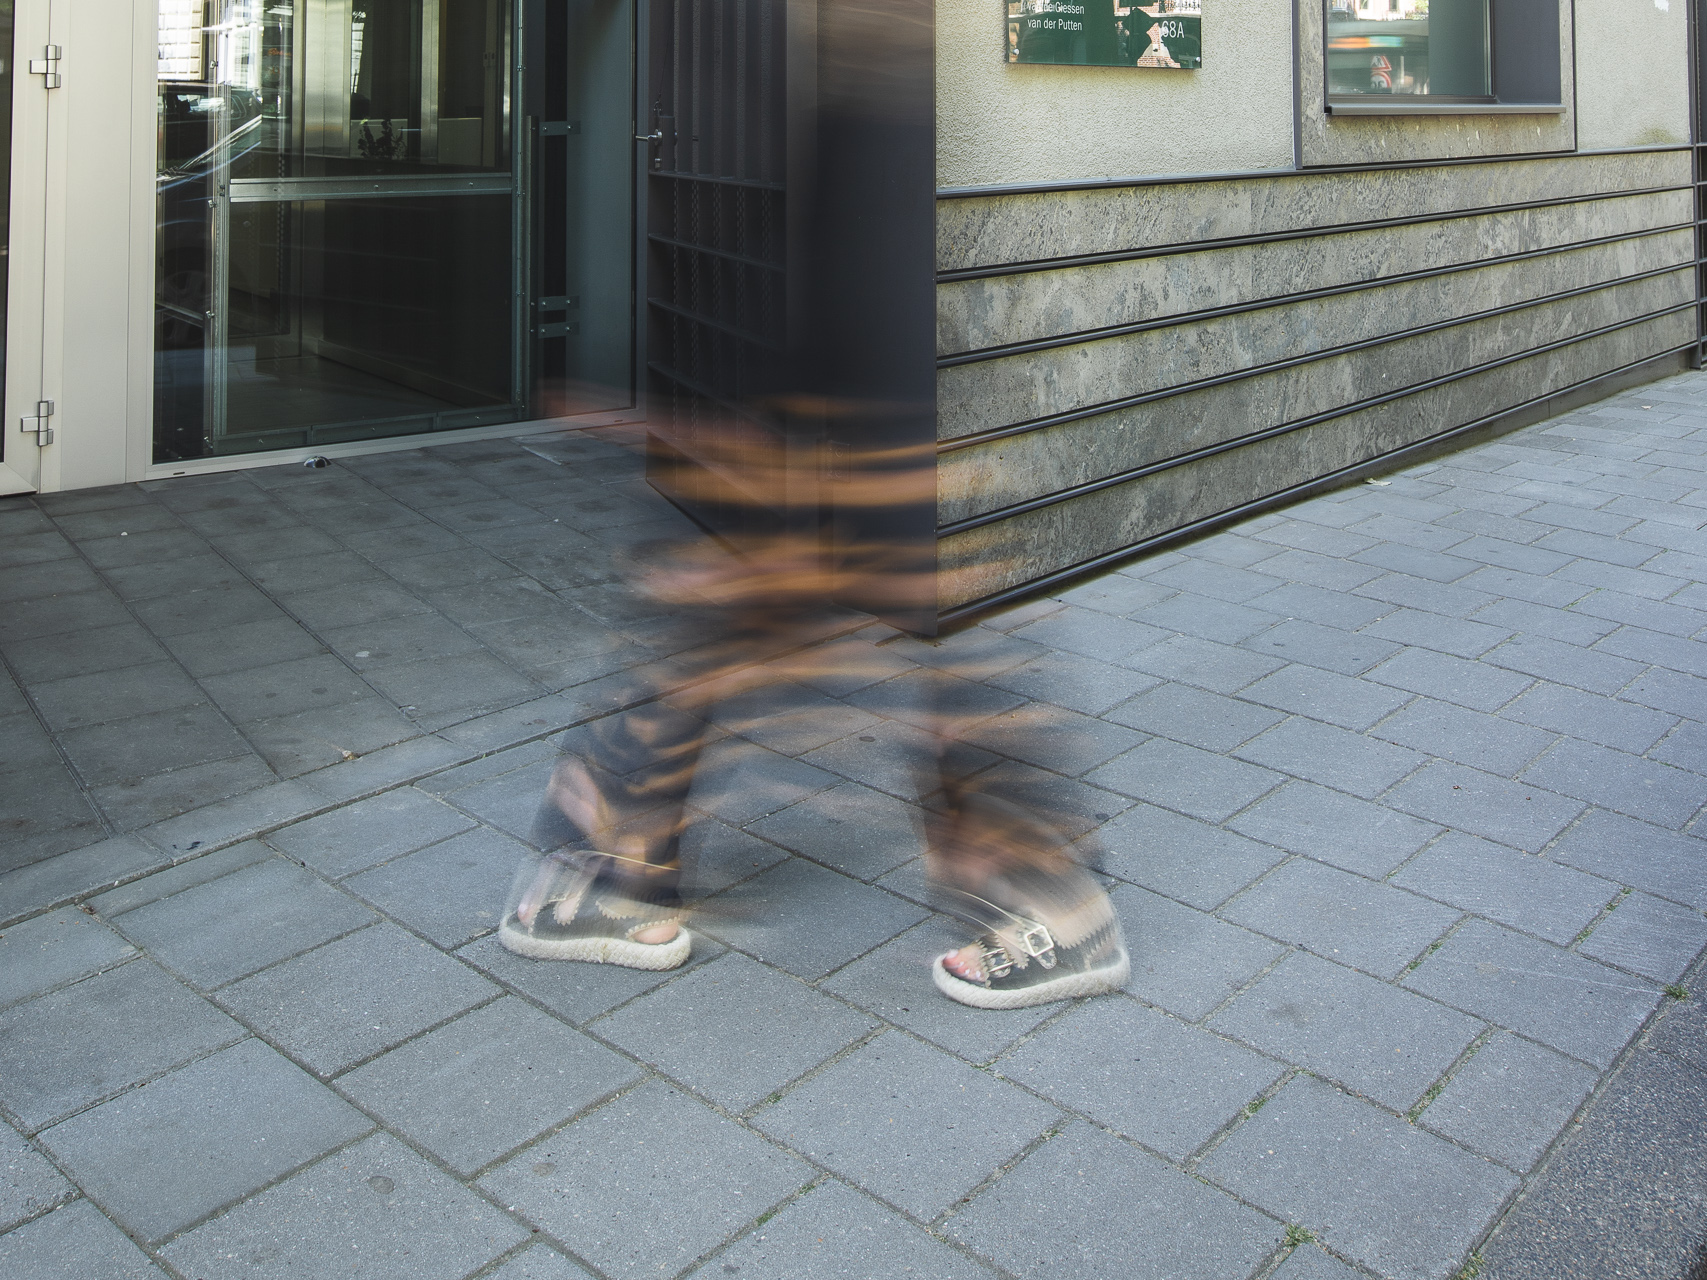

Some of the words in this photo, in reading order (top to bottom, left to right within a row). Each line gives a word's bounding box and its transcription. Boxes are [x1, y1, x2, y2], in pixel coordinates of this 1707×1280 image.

[1055, 1, 1085, 15] Giessen
[1027, 19, 1042, 29] van
[1043, 18, 1056, 30] der
[1058, 18, 1083, 31] Putten
[1161, 20, 1185, 39] 68A
